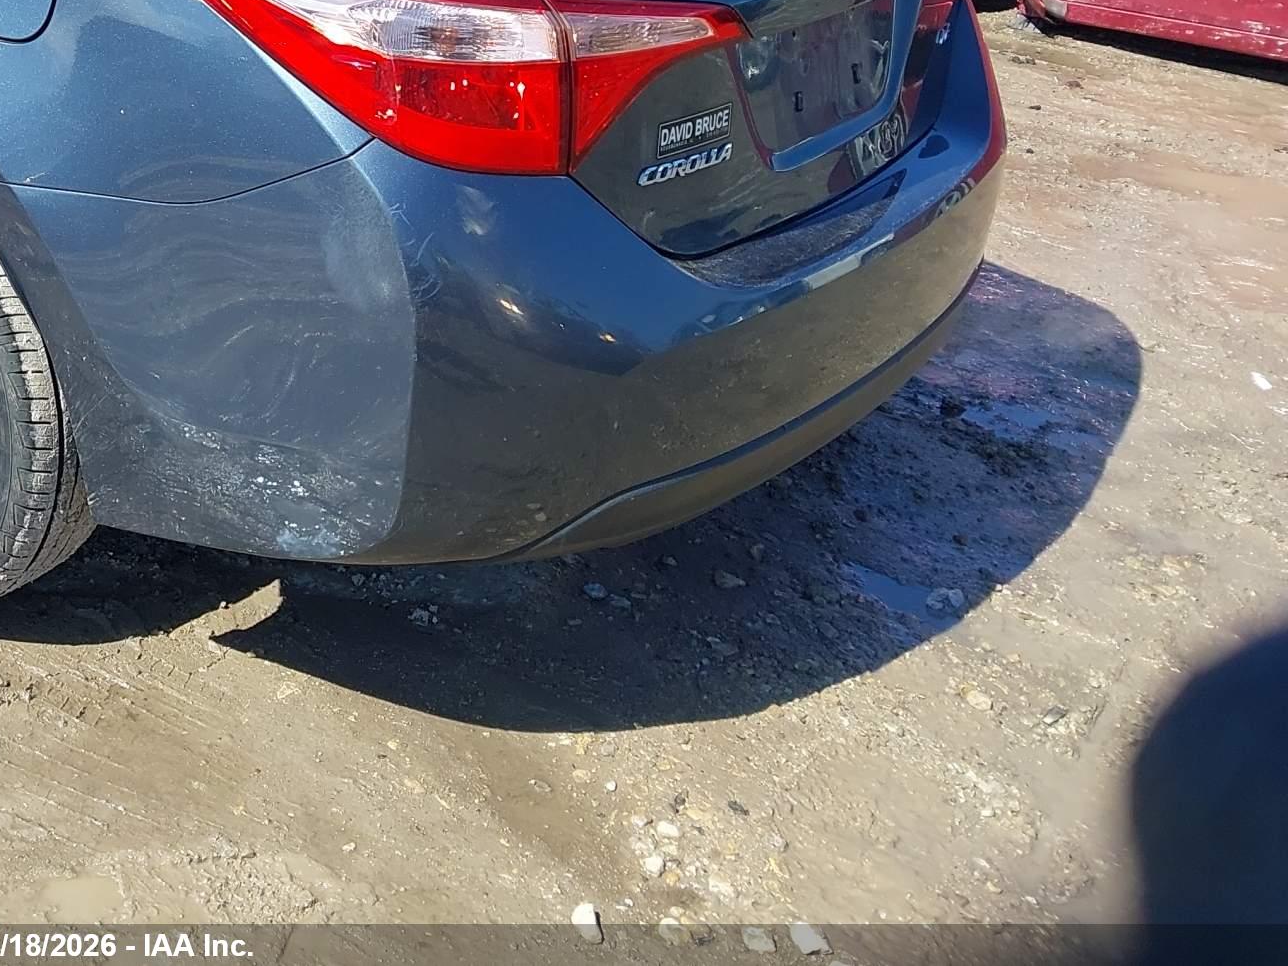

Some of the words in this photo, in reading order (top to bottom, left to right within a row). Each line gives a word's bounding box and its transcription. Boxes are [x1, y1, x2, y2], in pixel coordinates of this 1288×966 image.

[660, 122, 693, 147] DAVID
[695, 109, 730, 137] BRUCE
[637, 143, 733, 186] COROLLA
